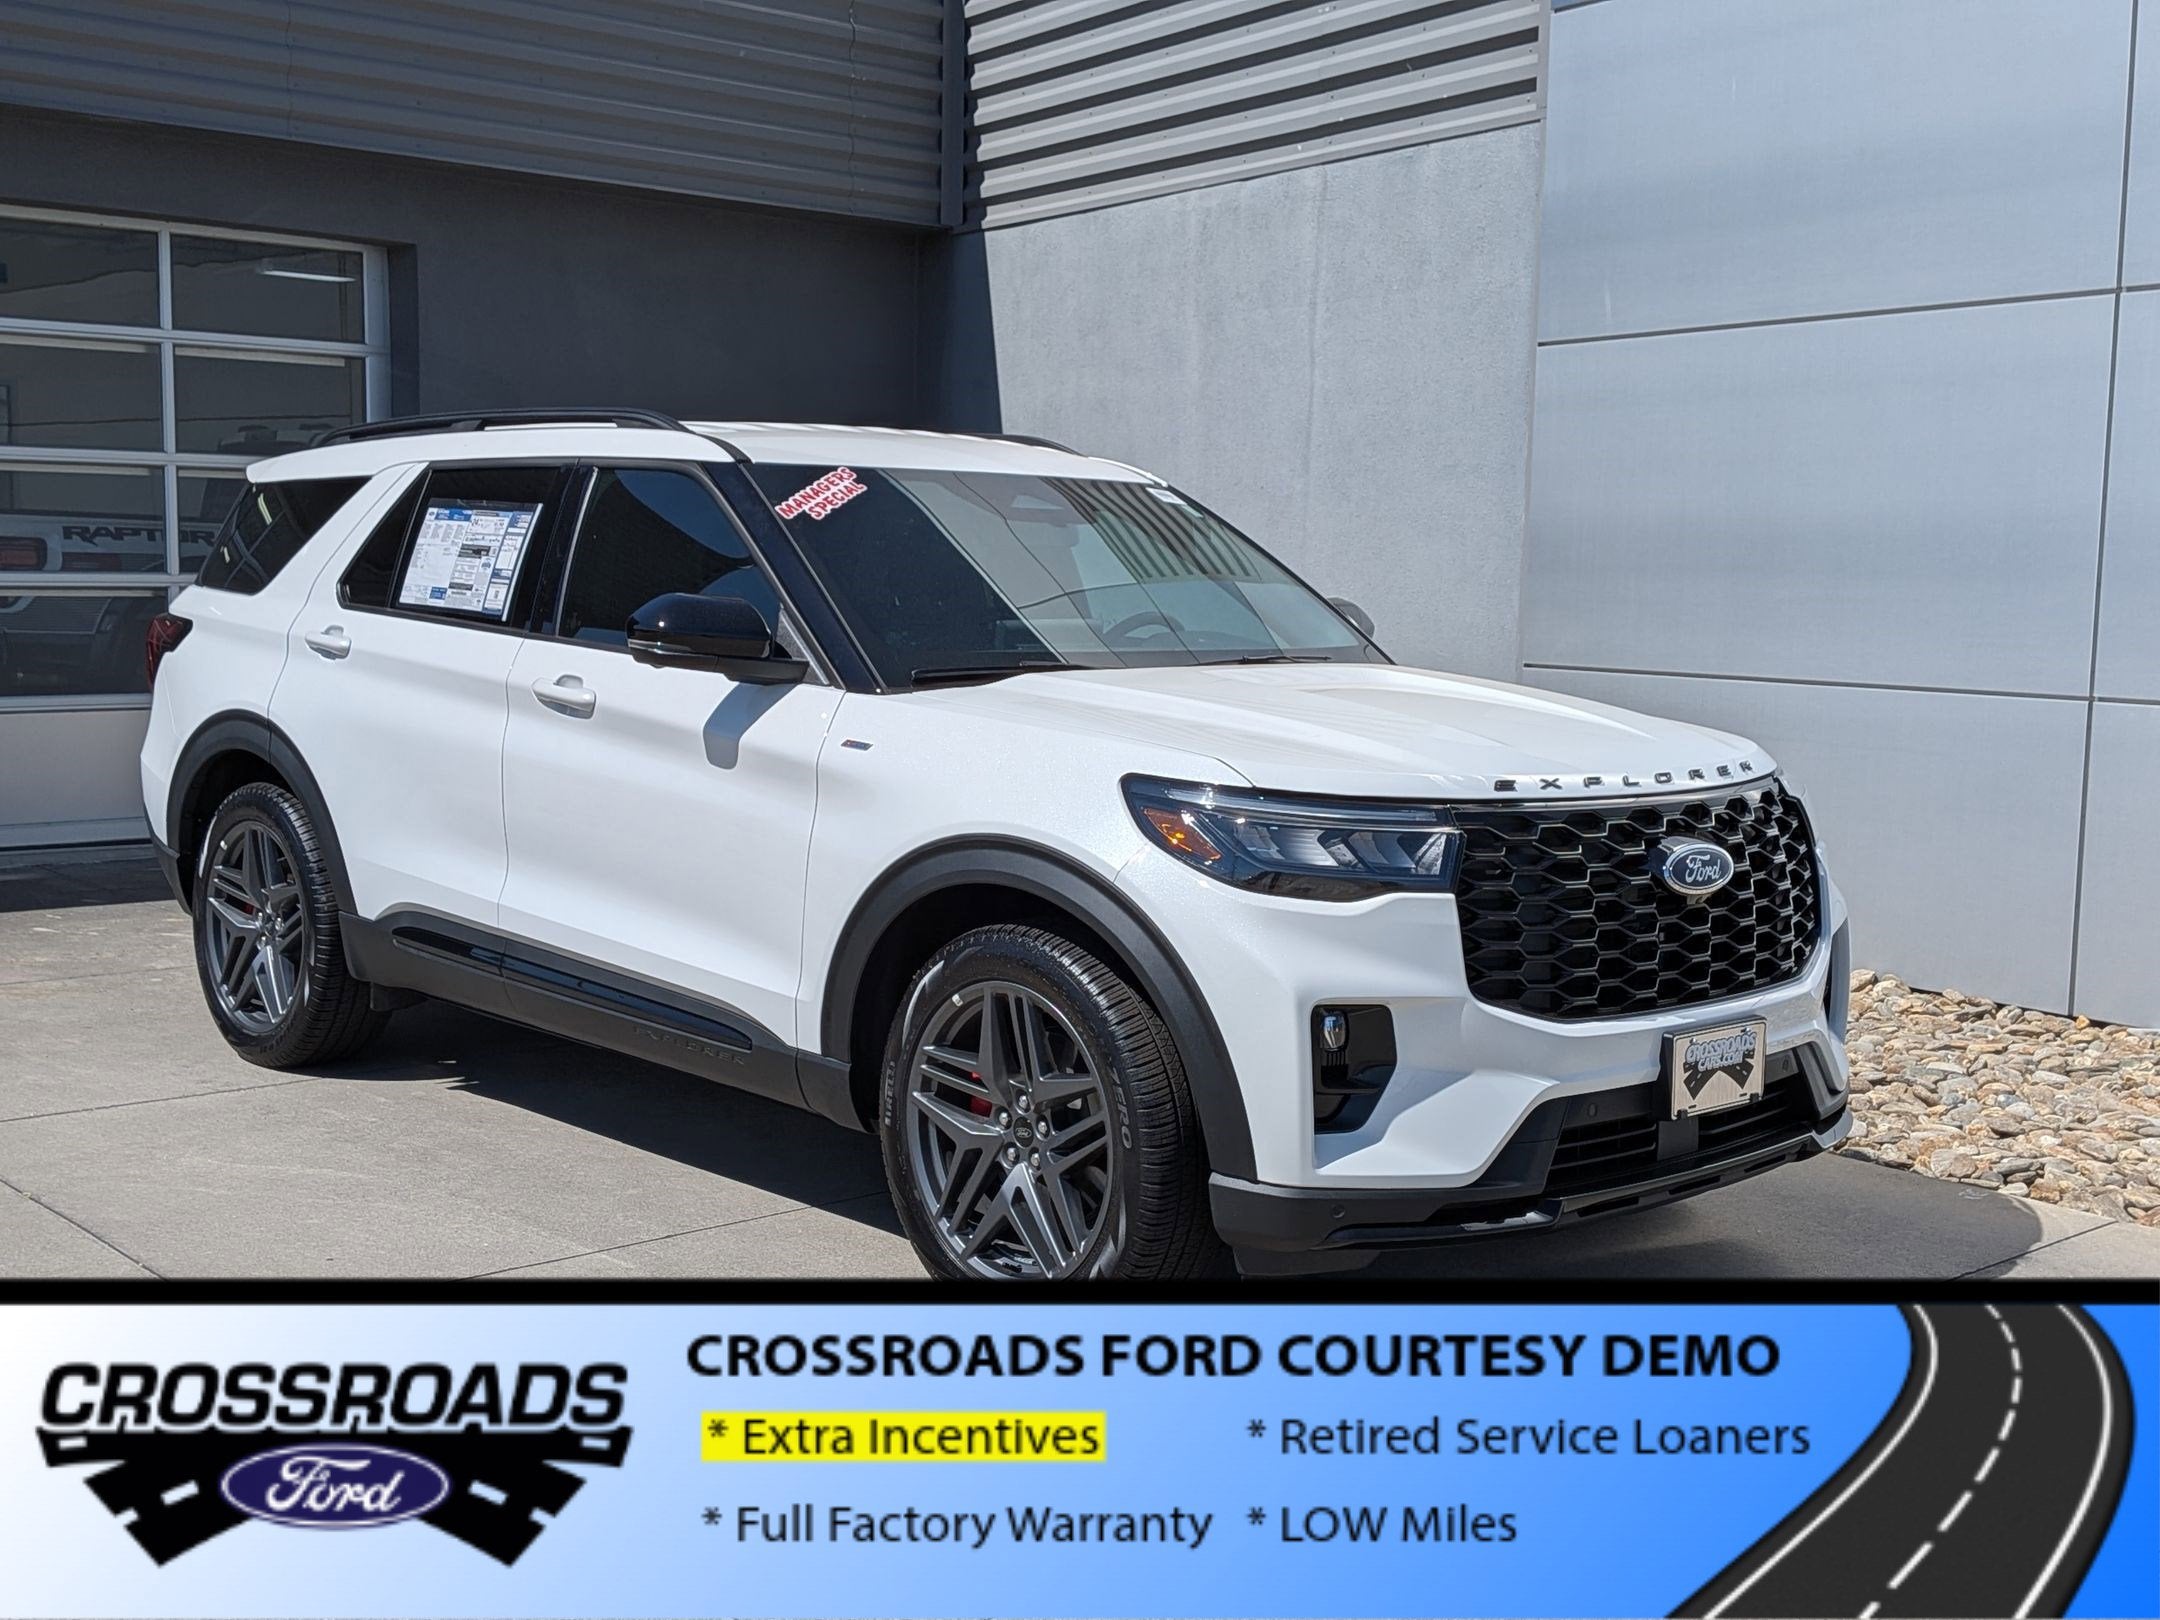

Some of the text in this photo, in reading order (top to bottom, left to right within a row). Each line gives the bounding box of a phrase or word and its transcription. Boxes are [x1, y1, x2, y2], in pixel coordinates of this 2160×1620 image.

[777, 467, 855, 518] MANAGERS
[807, 481, 865, 518] SPECIAL
[1493, 759, 1754, 793] EXPLORER
[1685, 854, 1721, 883] Ford
[1685, 1031, 1757, 1064] CROSSROADS
